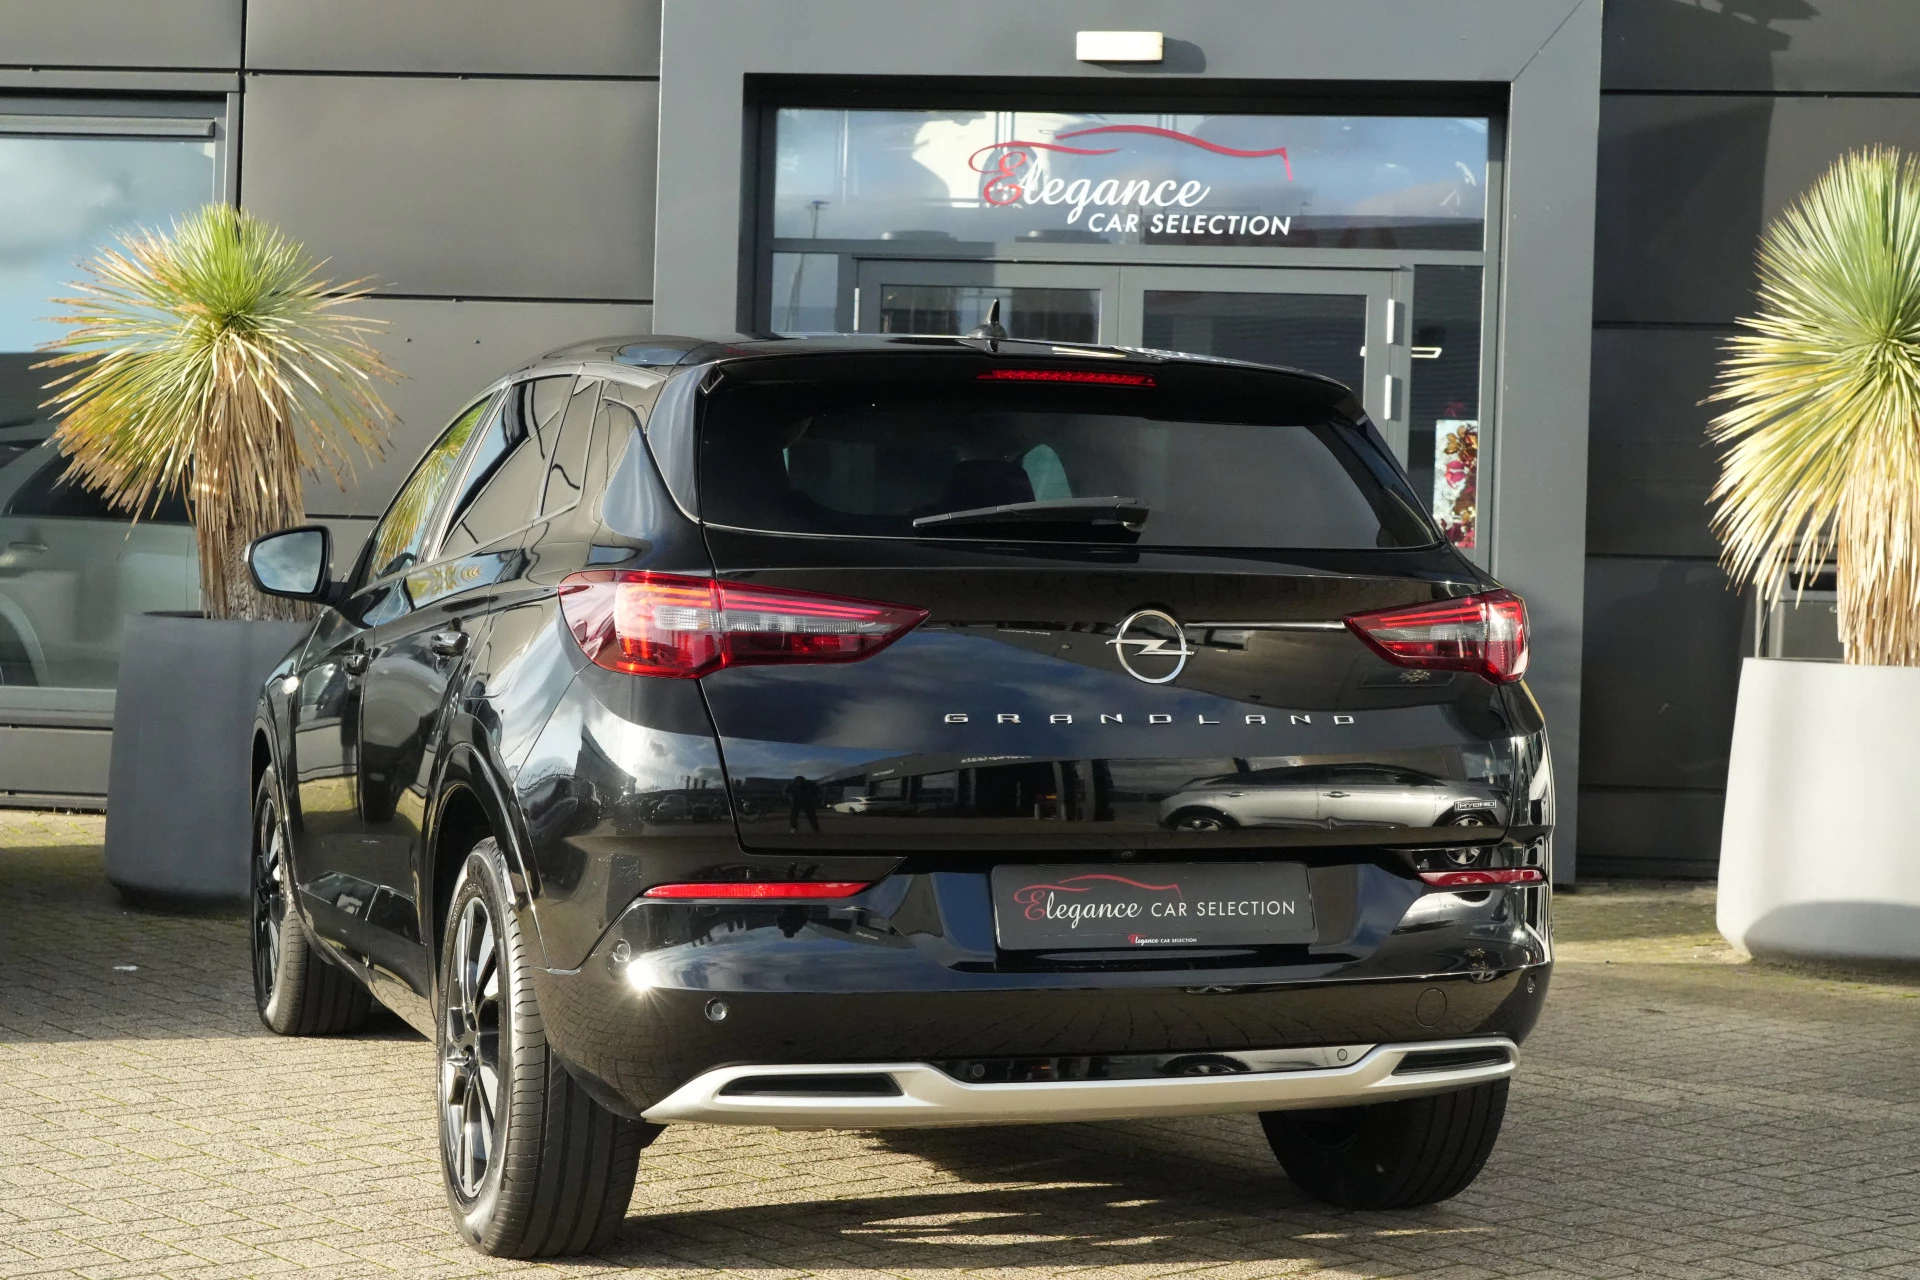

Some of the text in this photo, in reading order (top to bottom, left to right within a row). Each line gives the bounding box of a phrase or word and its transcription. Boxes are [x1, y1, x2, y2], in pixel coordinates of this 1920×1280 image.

[970, 144, 1210, 225] Elegance
[1088, 213, 1291, 236] CAR SELECTION
[944, 712, 1355, 725] GRANDLAND
[1015, 886, 1295, 929] Elegance CAR SELECTION
